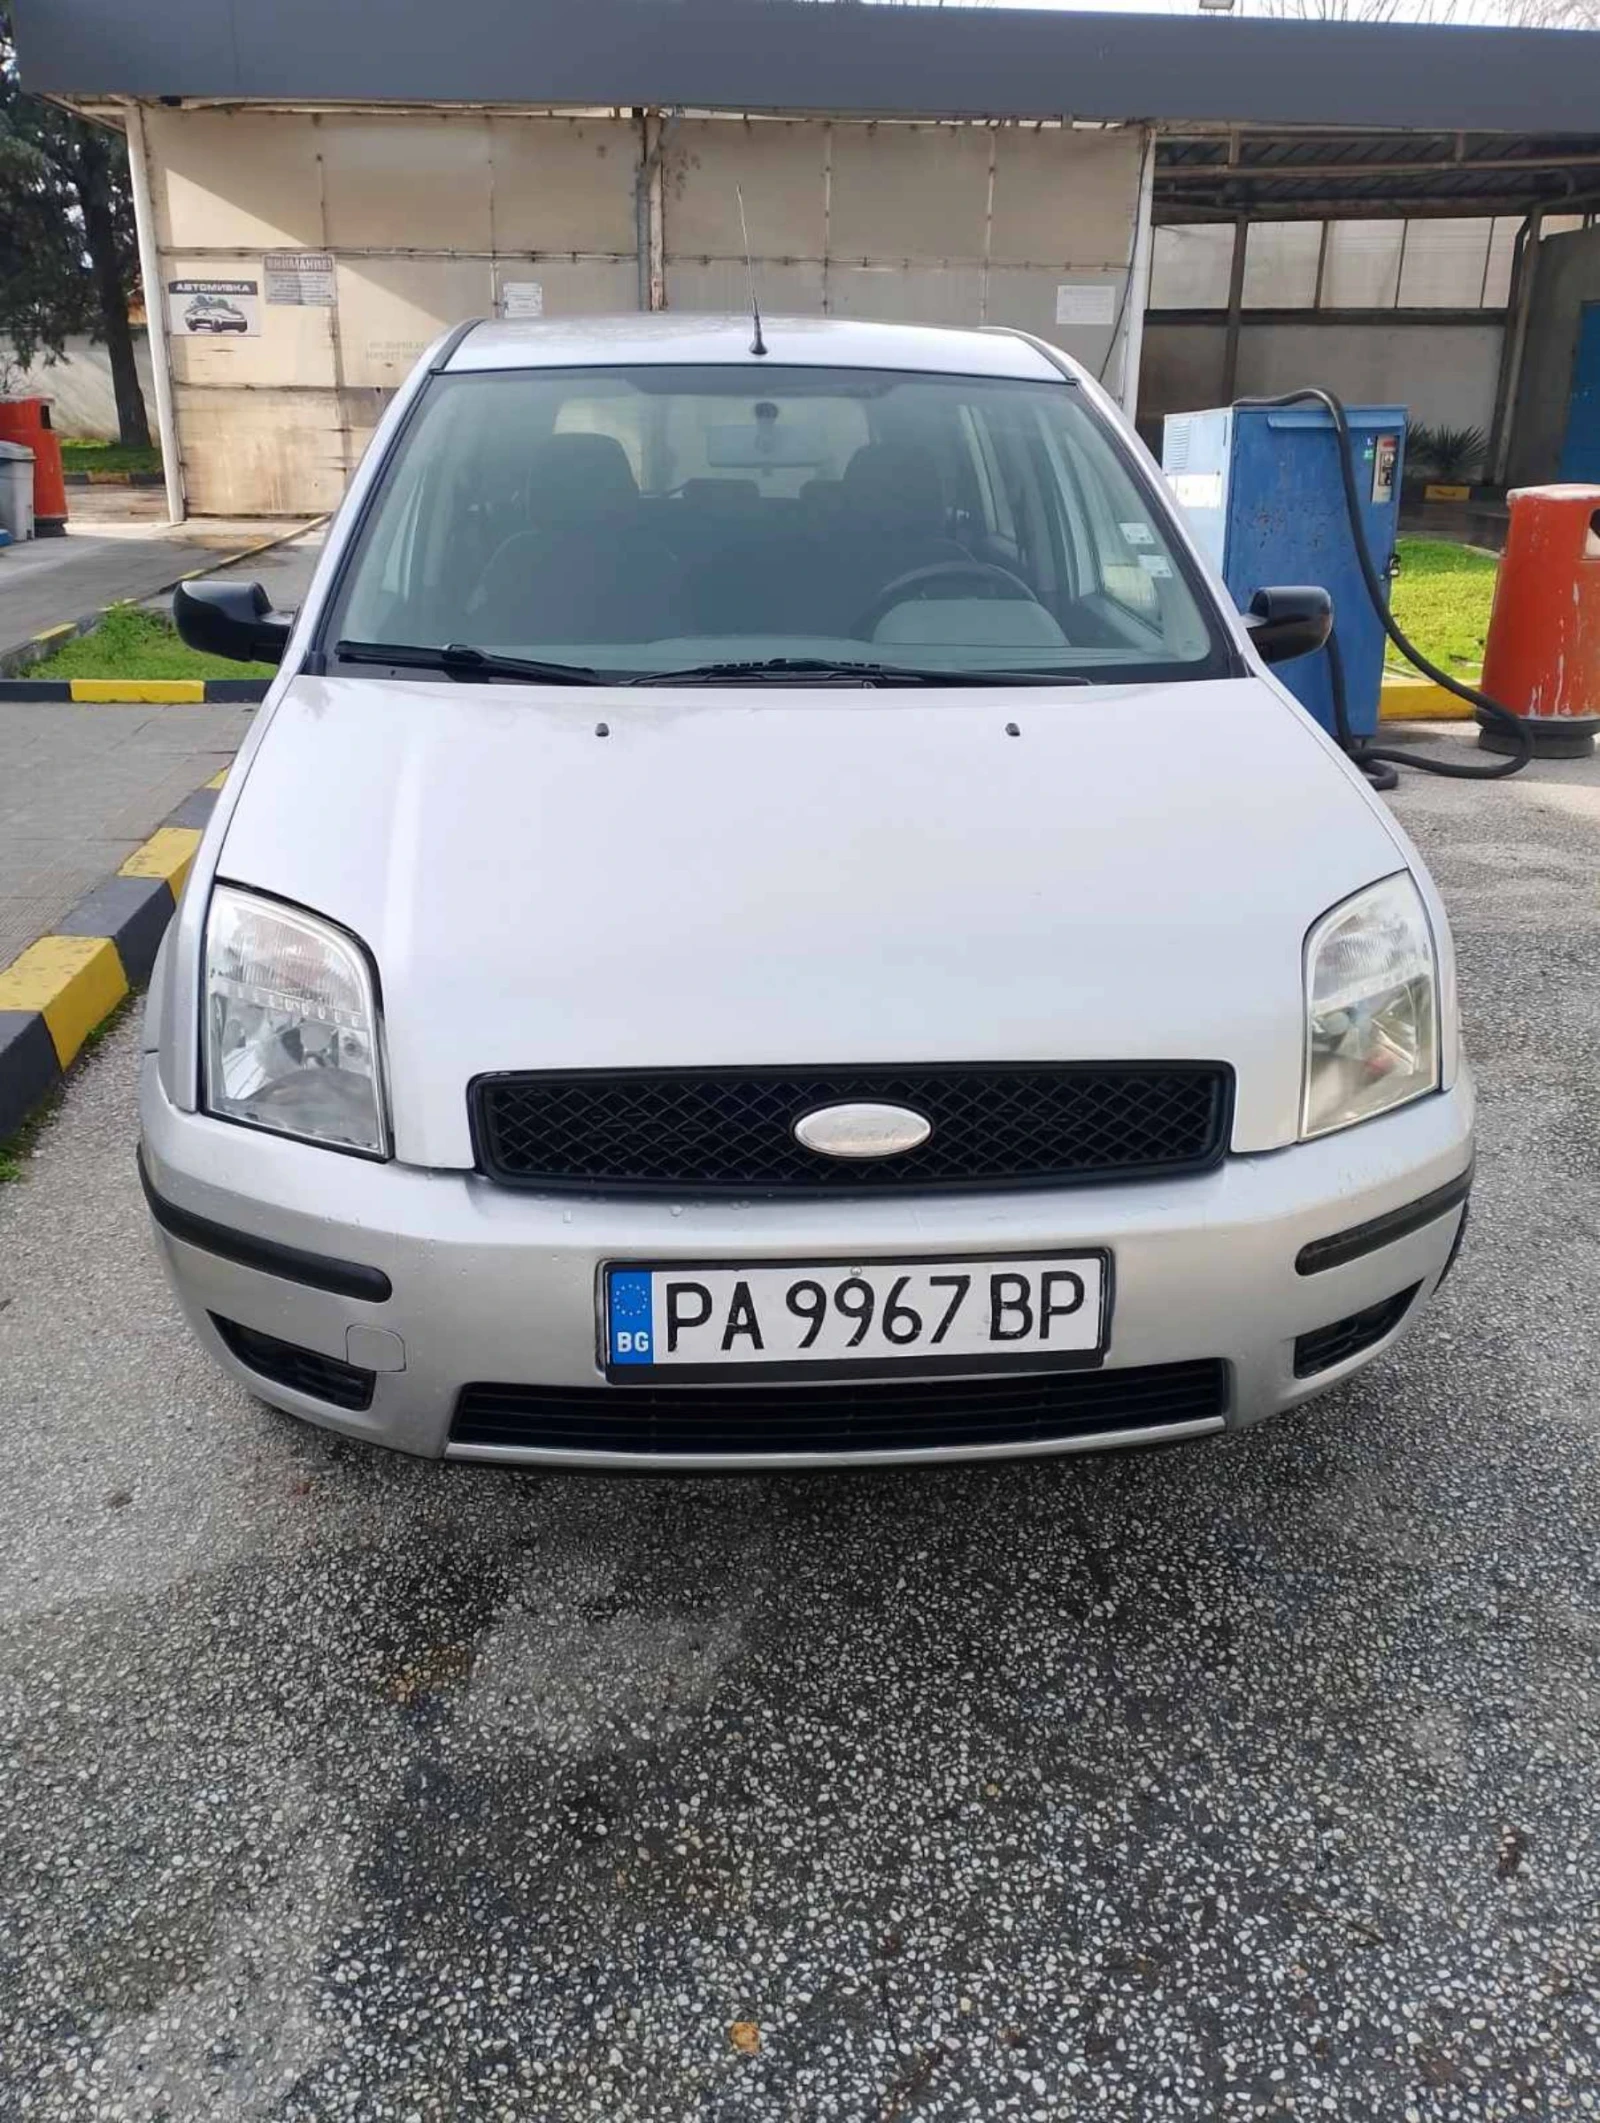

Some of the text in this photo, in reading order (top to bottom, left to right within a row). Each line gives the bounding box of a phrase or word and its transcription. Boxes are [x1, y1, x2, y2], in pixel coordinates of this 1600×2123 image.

[175, 283, 251, 293] АВТОМИВКА
[666, 1271, 1085, 1352] PA 9967 BP
[617, 1332, 649, 1352] BG
